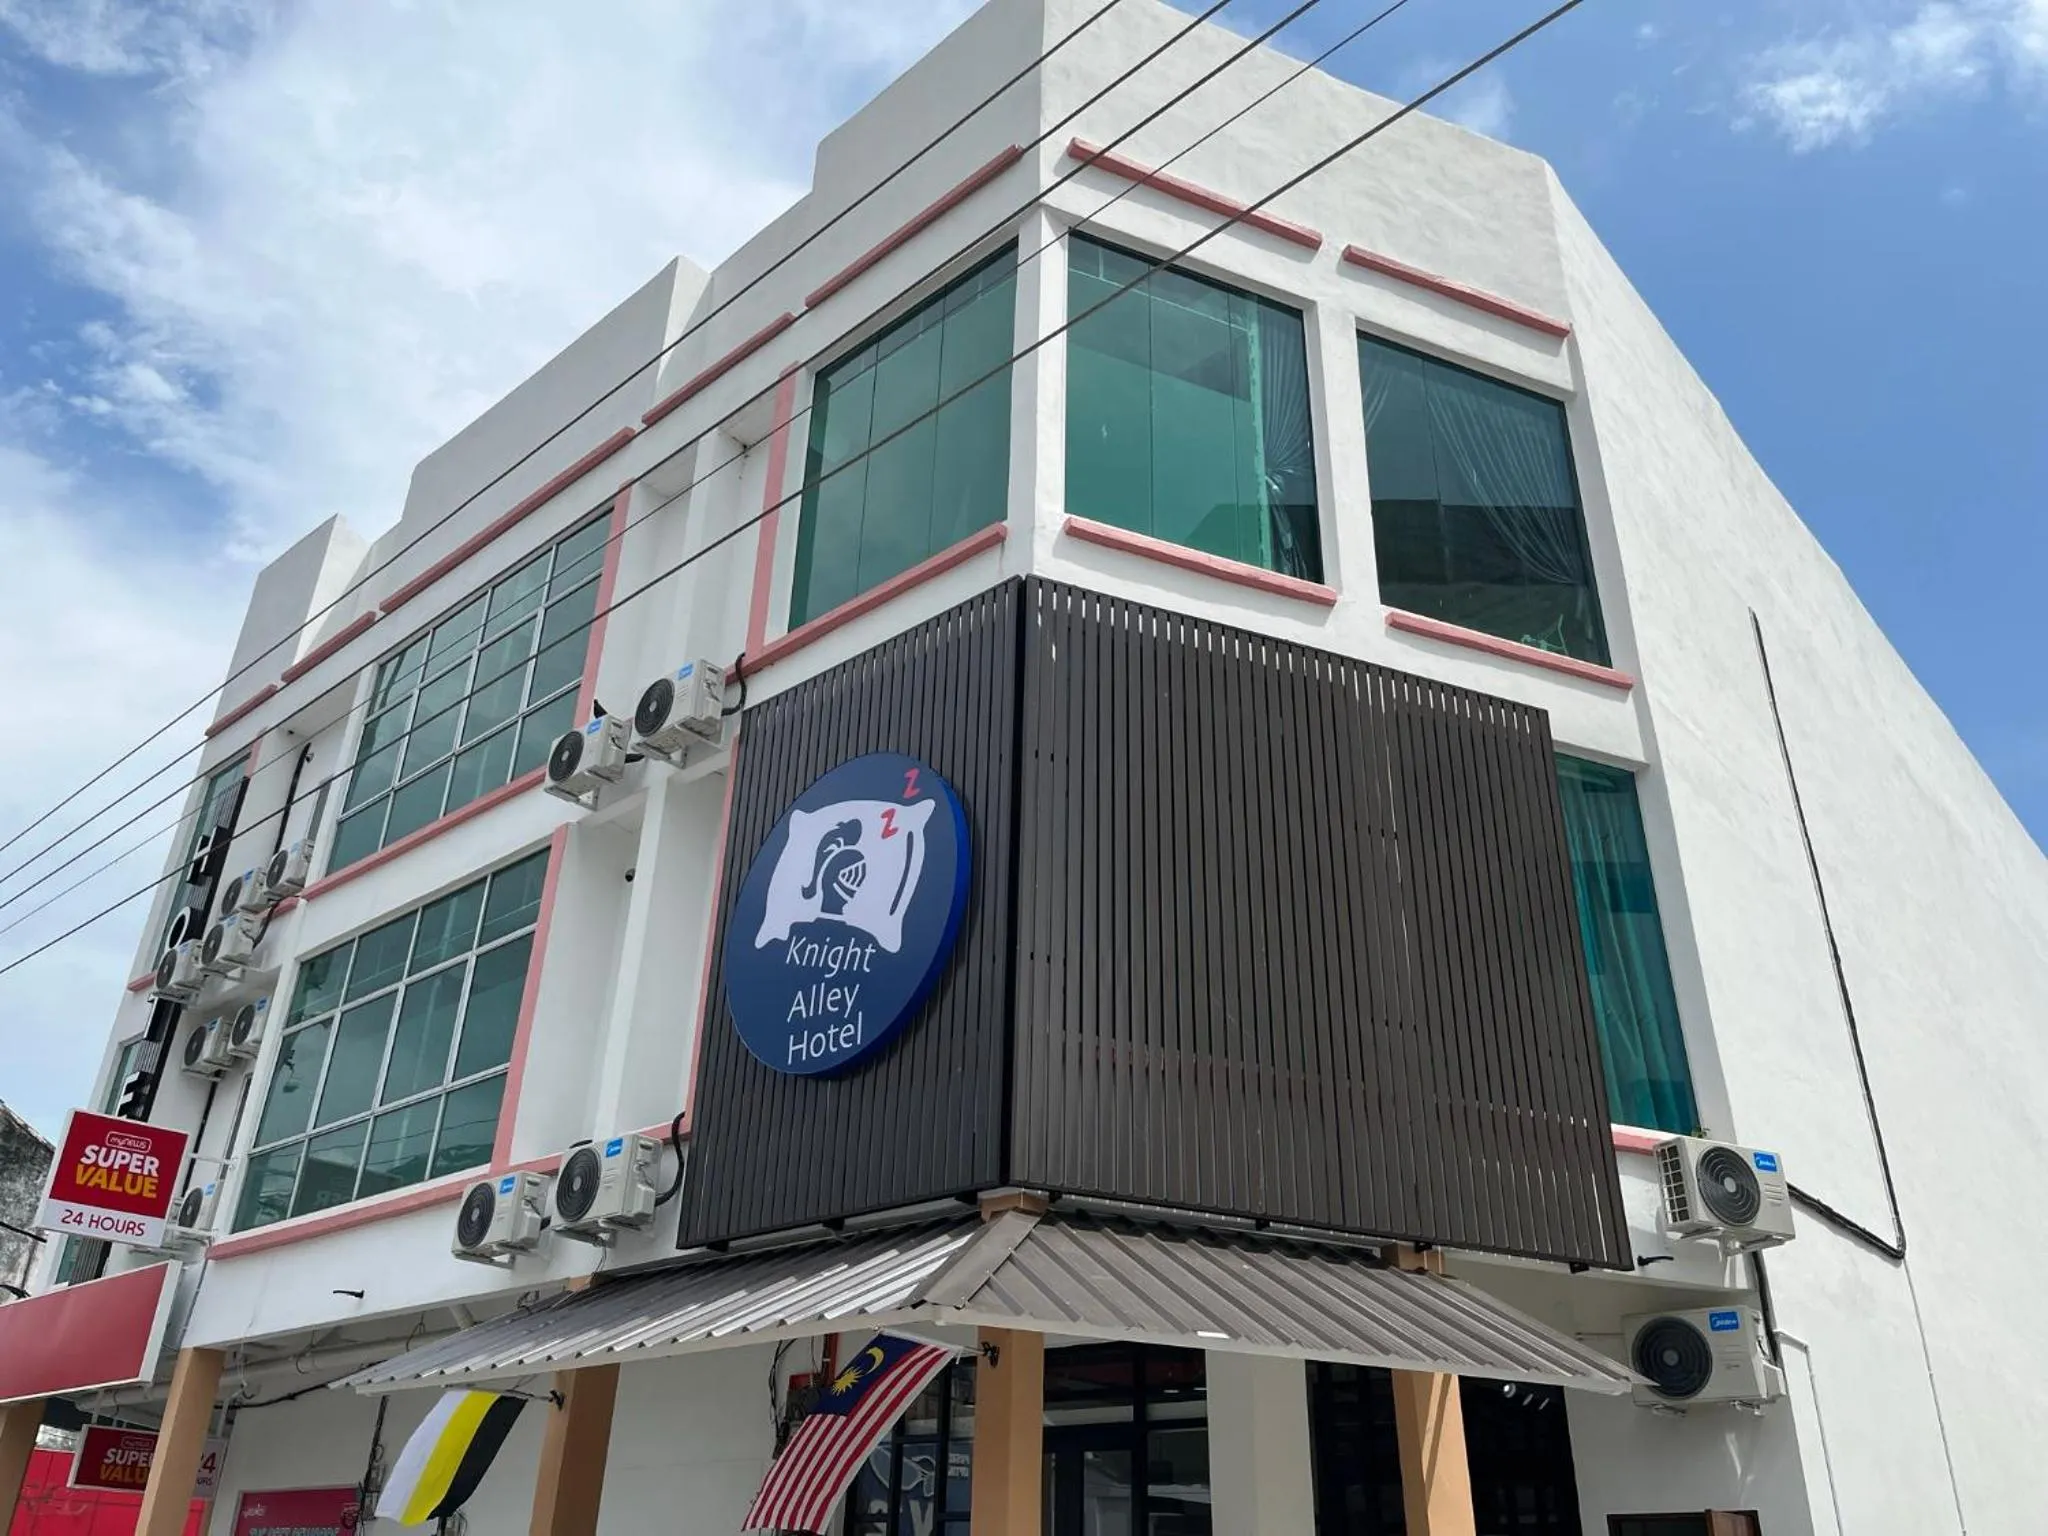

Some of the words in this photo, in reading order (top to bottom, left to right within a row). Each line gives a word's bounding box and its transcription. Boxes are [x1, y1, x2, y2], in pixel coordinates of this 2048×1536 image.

[786, 935, 876, 978] Knight
[787, 982, 860, 1023] Alley
[788, 1011, 862, 1065] Hotel
[80, 1144, 160, 1178] SUPER
[75, 1164, 159, 1198] VALUE
[61, 1209, 83, 1226] 24
[88, 1214, 146, 1237] HOURS
[100, 1464, 150, 1483] VALU
[198, 1452, 217, 1473] 4
